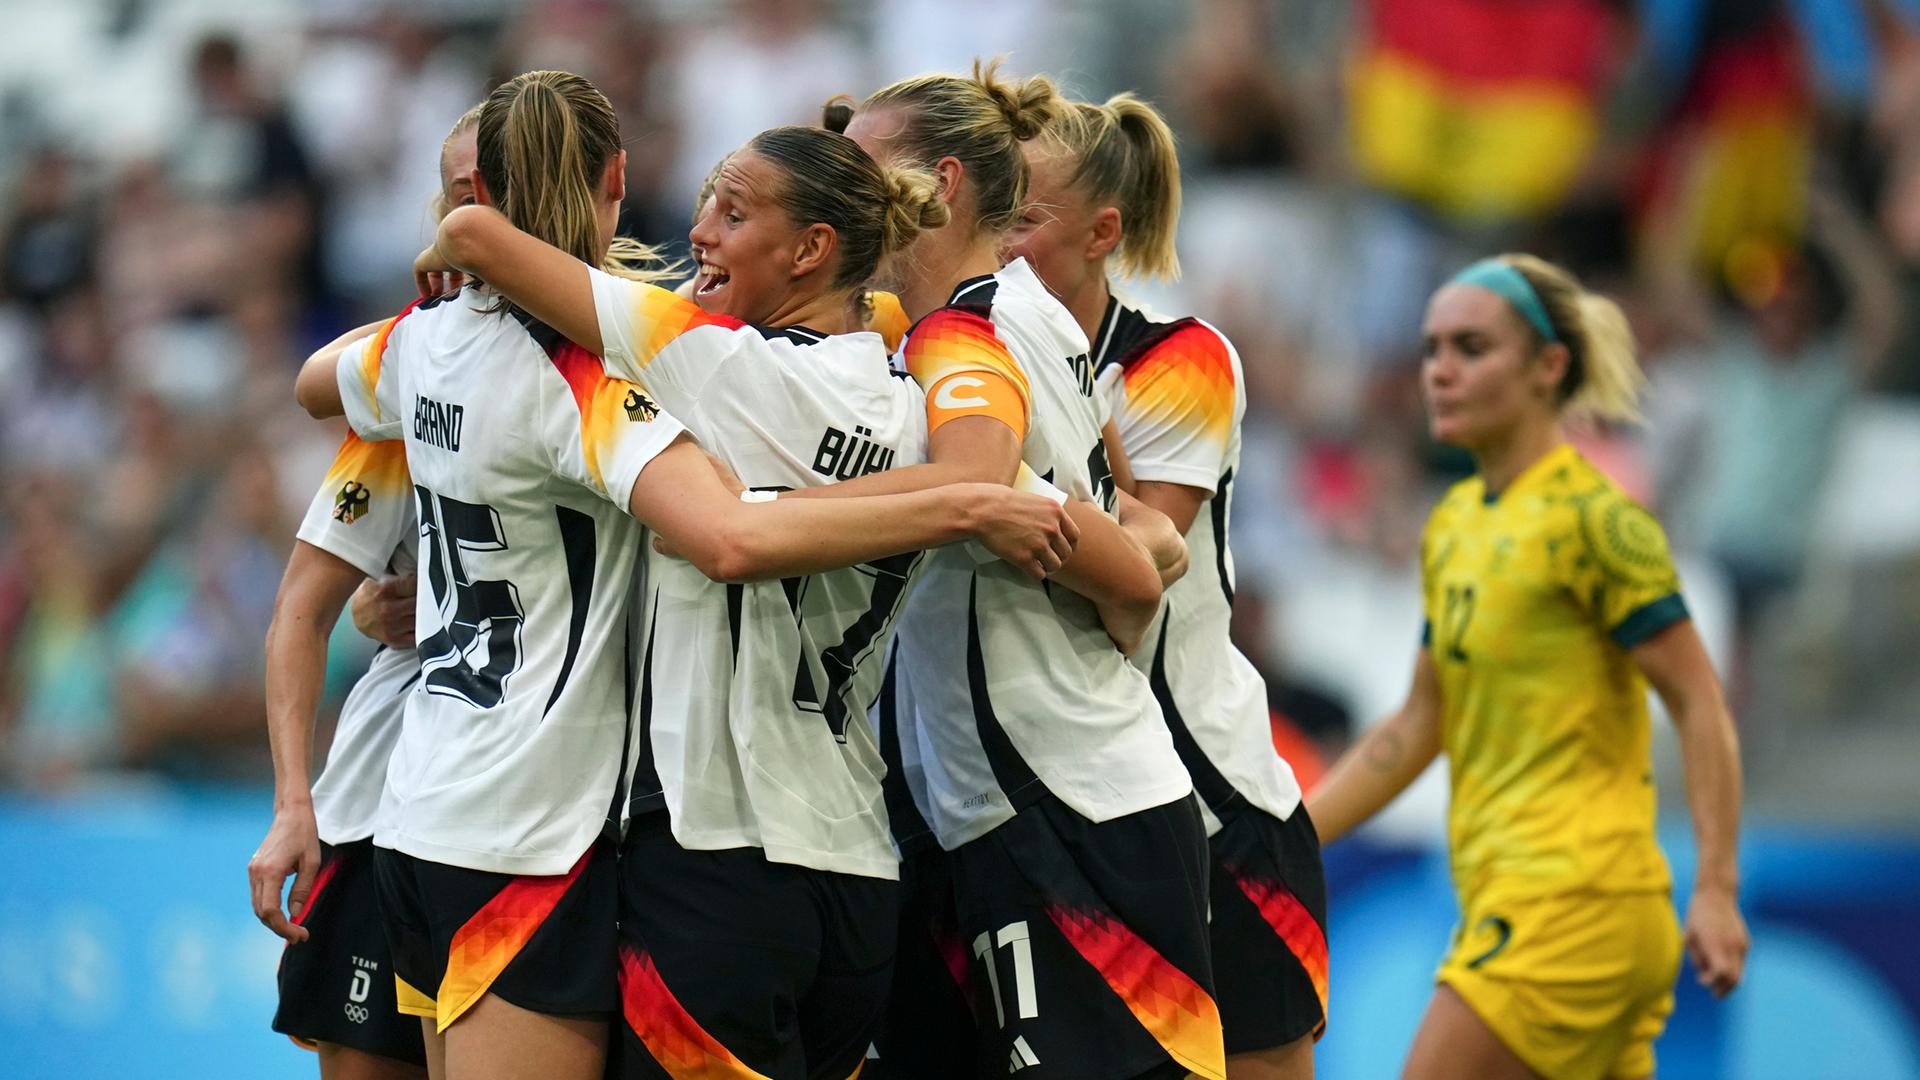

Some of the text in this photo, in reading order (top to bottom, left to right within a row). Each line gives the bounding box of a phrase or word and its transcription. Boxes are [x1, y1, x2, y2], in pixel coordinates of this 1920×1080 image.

[934, 376, 990, 410] C
[414, 392, 464, 453] BRAND
[352, 956, 378, 970] TEAM
[972, 920, 1039, 1030] 11
[349, 969, 371, 1003] D
